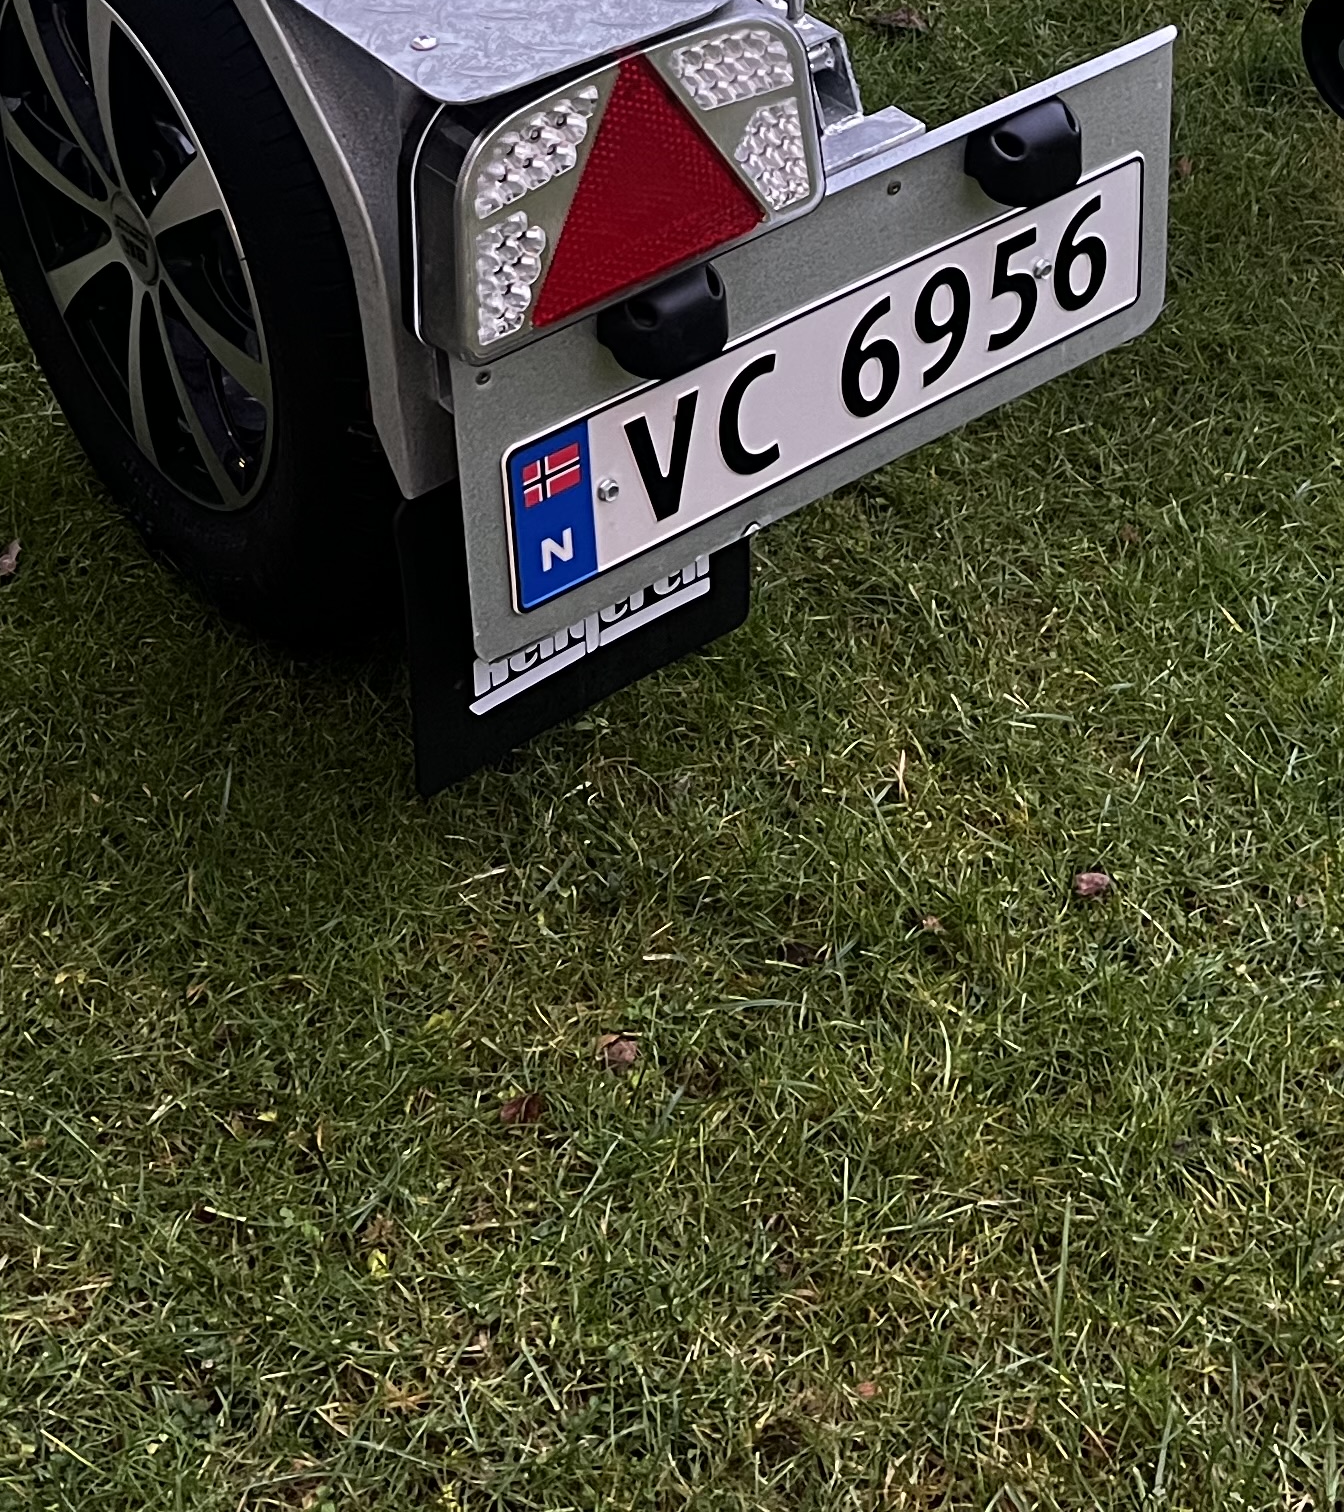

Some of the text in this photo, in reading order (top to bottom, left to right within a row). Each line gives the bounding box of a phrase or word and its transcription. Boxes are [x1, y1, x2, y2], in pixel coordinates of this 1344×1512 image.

[624, 194, 1108, 523] VC 6956
[540, 526, 574, 572] N
